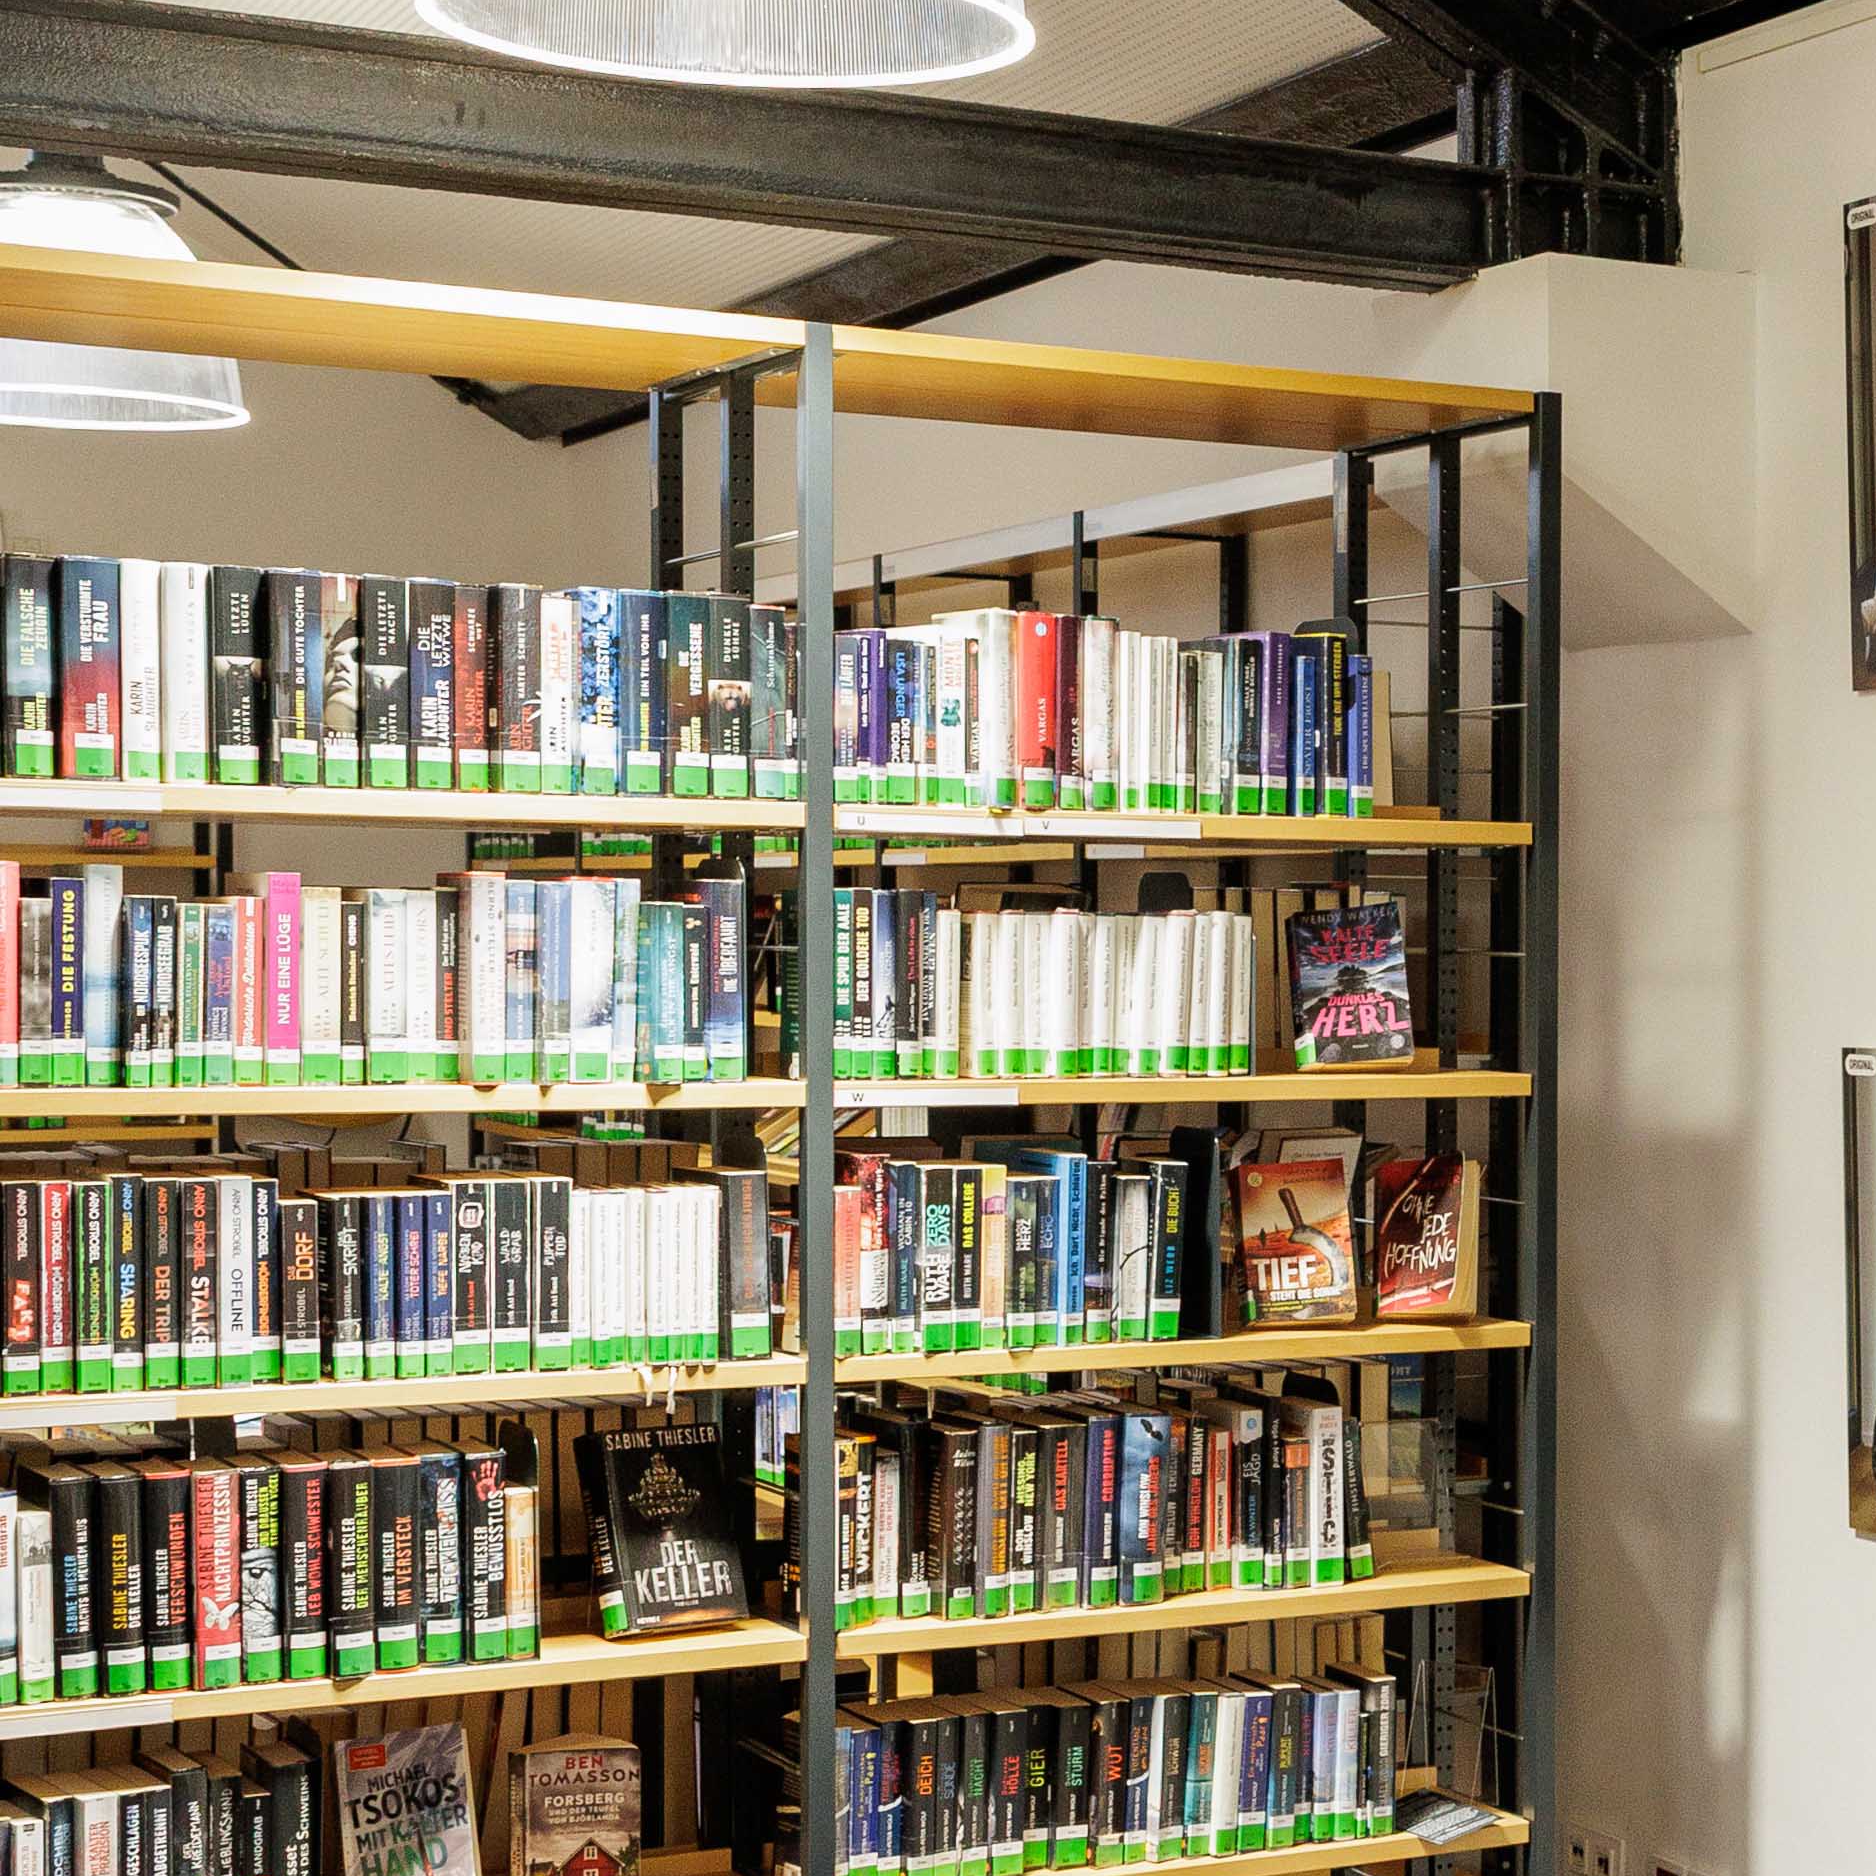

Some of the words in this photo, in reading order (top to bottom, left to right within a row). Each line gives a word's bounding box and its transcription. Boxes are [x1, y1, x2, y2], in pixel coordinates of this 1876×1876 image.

[1850, 209, 1876, 223] ORIGINAL
[19, 588, 34, 642] FALSCHE
[34, 606, 49, 650] ZEUGIN
[80, 579, 93, 643] VERSTUMMTE
[93, 601, 109, 642] FRAU
[295, 586, 306, 633] TOCHTER
[19, 646, 34, 666] DIE
[80, 645, 93, 662] DIE
[295, 636, 306, 663] GUTE
[417, 627, 431, 651] DIE
[430, 614, 442, 667] LETZTE
[441, 614, 452, 667] WITWE
[295, 667, 306, 684] DIE
[689, 623, 703, 696] VERGESSENE
[896, 653, 905, 677] LISA
[421, 697, 437, 737] KARIN
[896, 680, 906, 717] UNGER
[1038, 698, 1047, 742] VARGAS
[857, 815, 865, 826] U
[1042, 820, 1049, 830] V
[62, 890, 75, 962] FESTUNG
[275, 913, 291, 951] LÜGE
[837, 904, 850, 930] AALE
[856, 908, 869, 929] TOD
[1321, 925, 1376, 943] KALTE
[718, 916, 738, 975] ÜBERFAHRT
[837, 933, 850, 953] DER
[856, 932, 870, 979] GOLDENE
[1310, 938, 1391, 964] SEELE
[62, 967, 75, 993] DIE
[133, 930, 150, 1002] NORDSEESPUK
[157, 926, 173, 1002] NORDSEEGRAB
[277, 957, 291, 988] EINE
[837, 956, 850, 984] SPUR
[277, 993, 291, 1024] NUR
[837, 989, 850, 1005] DIE
[856, 982, 870, 1002] DER
[1328, 993, 1385, 1007] DUNKLES
[1312, 1001, 1410, 1038] HERZ
[1849, 1058, 1874, 1072] ORIGINAL
[852, 1092, 864, 1102] W
[88, 1192, 100, 1218] ARNO
[121, 1183, 133, 1210] ARNO
[963, 1182, 974, 1225] COLLEGE
[1402, 1193, 1436, 1224] OHNE
[88, 1222, 100, 1264] STROBEL
[121, 1213, 133, 1254] STROBEL
[925, 1205, 939, 1246] ZERO
[938, 1205, 951, 1246] DAYS
[963, 1227, 974, 1248] DAS
[1420, 1212, 1453, 1244] JEDE
[295, 1232, 314, 1280] DORF
[343, 1227, 359, 1275] SKRIPT
[500, 1230, 511, 1264] WALD
[510, 1230, 522, 1264] GRAB
[543, 1227, 556, 1265] PUPPEN
[555, 1238, 567, 1257] TOD
[1384, 1238, 1456, 1279] HOFFNUNG
[155, 1265, 170, 1300] DER
[287, 1266, 296, 1280] DAS
[925, 1254, 939, 1302] RUTH
[938, 1254, 951, 1301] WARE
[1253, 1255, 1318, 1291] TIEF
[119, 1264, 136, 1338] SHARING
[231, 1268, 244, 1331] OFFLINE
[155, 1305, 170, 1342] TRIP
[606, 1431, 652, 1451] SABINE
[656, 1425, 717, 1448] THIESLER
[1189, 1427, 1203, 1475] GERMANY
[1102, 1430, 1115, 1502] CORRUPTION
[1344, 1440, 1360, 1512] FINSTERWALD
[306, 1478, 321, 1550] SCHWESTER
[856, 1471, 872, 1574] WICKERT
[213, 1476, 232, 1602] NACHTPRINZESSIN
[354, 1482, 369, 1584] MENSCHENRÄUBER
[395, 1516, 412, 1582] VERSTECK
[437, 1478, 458, 1603] ZECKENBISS
[487, 1490, 505, 1582] BEWUSSTLOS
[169, 1512, 187, 1625] VERSCHWUNDEN
[659, 1539, 699, 1567] DER
[356, 1589, 369, 1608] DER
[396, 1590, 412, 1605] IM
[634, 1559, 733, 1605] KELLER
[307, 1593, 321, 1616] LEB
[367, 1763, 428, 1793] MICHAEL
[529, 1768, 640, 1789] TOMASSON
[565, 1755, 604, 1770] BEN
[918, 1755, 934, 1796] DEICH
[1029, 1749, 1045, 1787] GIER
[1070, 1746, 1084, 1786] STURM
[1106, 1745, 1123, 1781] WUT
[345, 1773, 461, 1829] TSOKOS
[544, 1792, 625, 1808] FORSBERG
[549, 1808, 567, 1817] UND
[570, 1807, 586, 1816] DER
[588, 1805, 620, 1815] TEUFEL
[189, 1802, 203, 1869] KREIDEMANN
[253, 1816, 264, 1874] SANDGRAB
[356, 1832, 387, 1854] MIT
